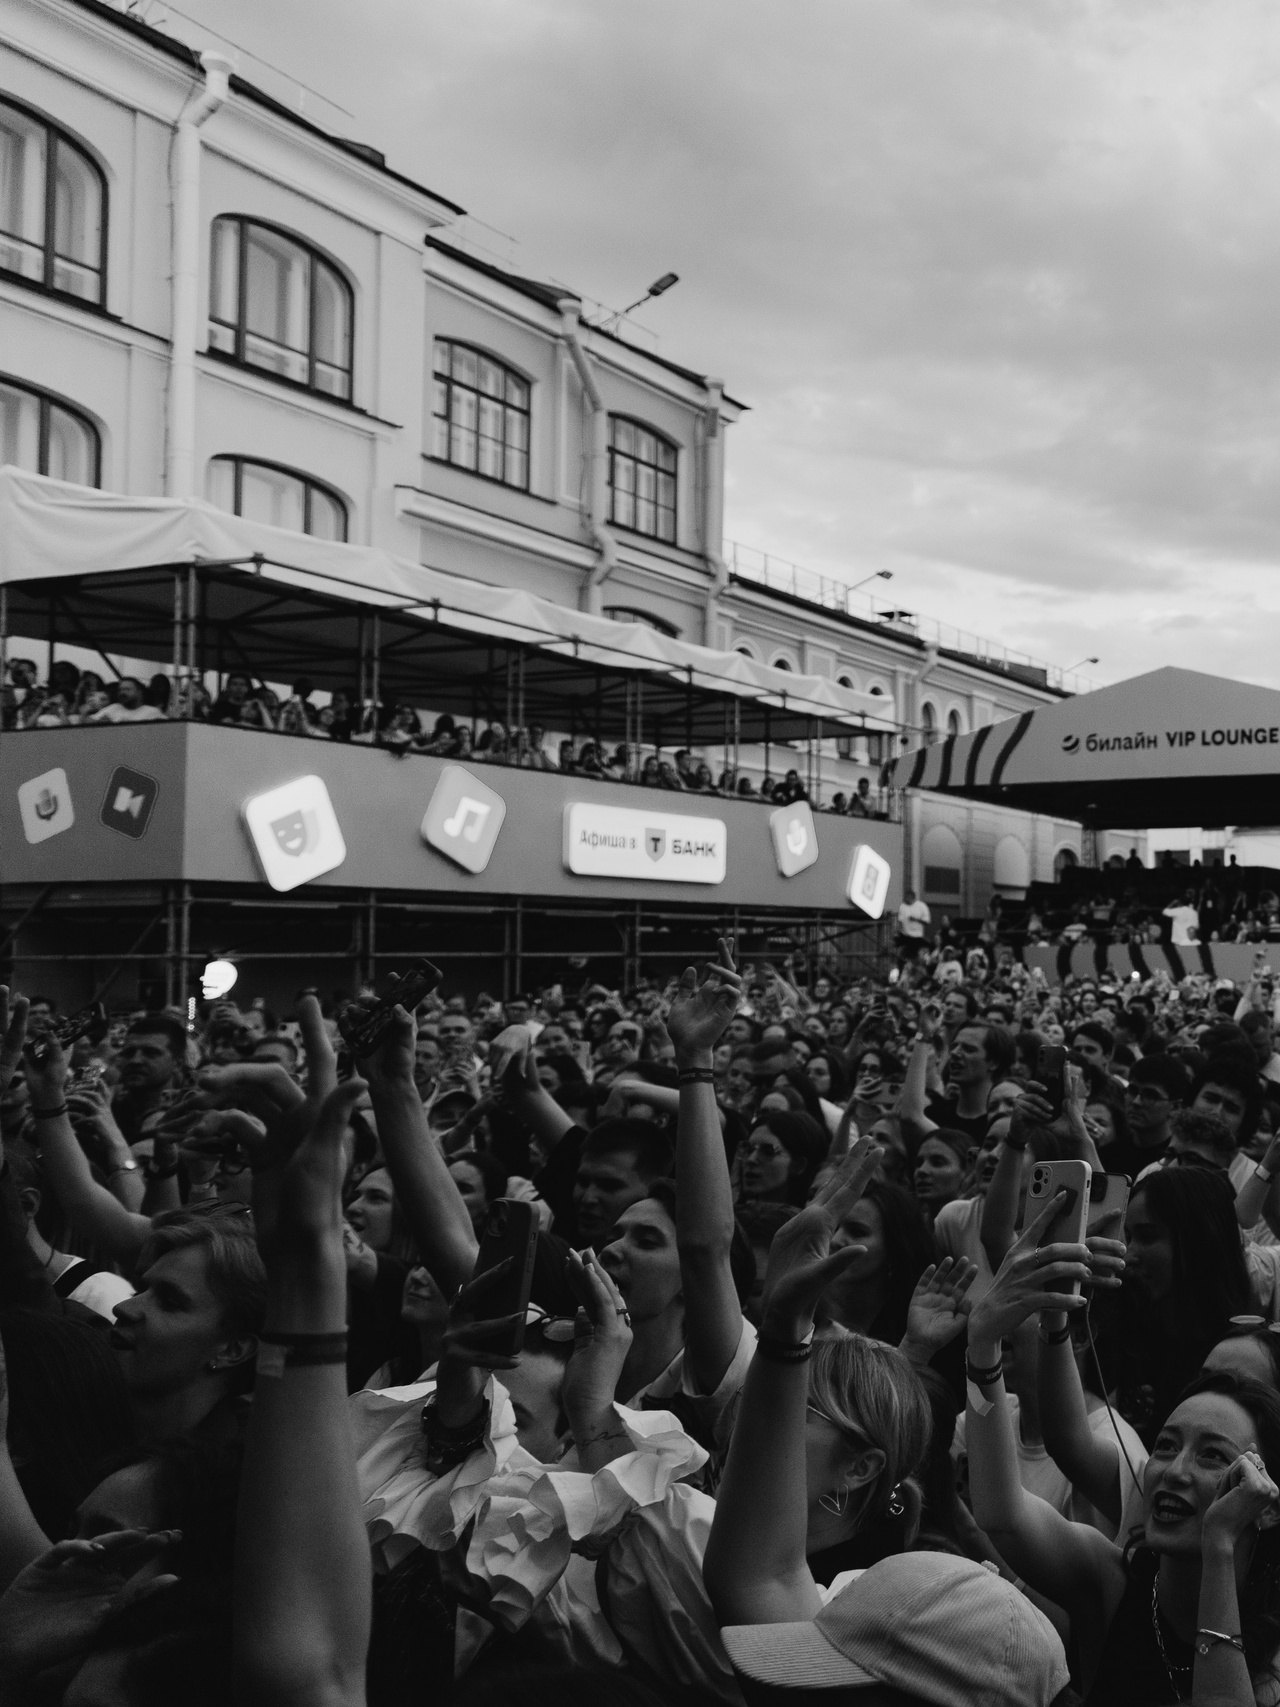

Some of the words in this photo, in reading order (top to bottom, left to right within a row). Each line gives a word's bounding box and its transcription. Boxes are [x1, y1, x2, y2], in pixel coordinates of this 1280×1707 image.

[1086, 731, 1158, 752] билайн
[1166, 730, 1196, 747] VIP
[1201, 727, 1279, 746] LOUNGE
[579, 830, 626, 849] Афиша
[672, 840, 716, 858] БАНК
